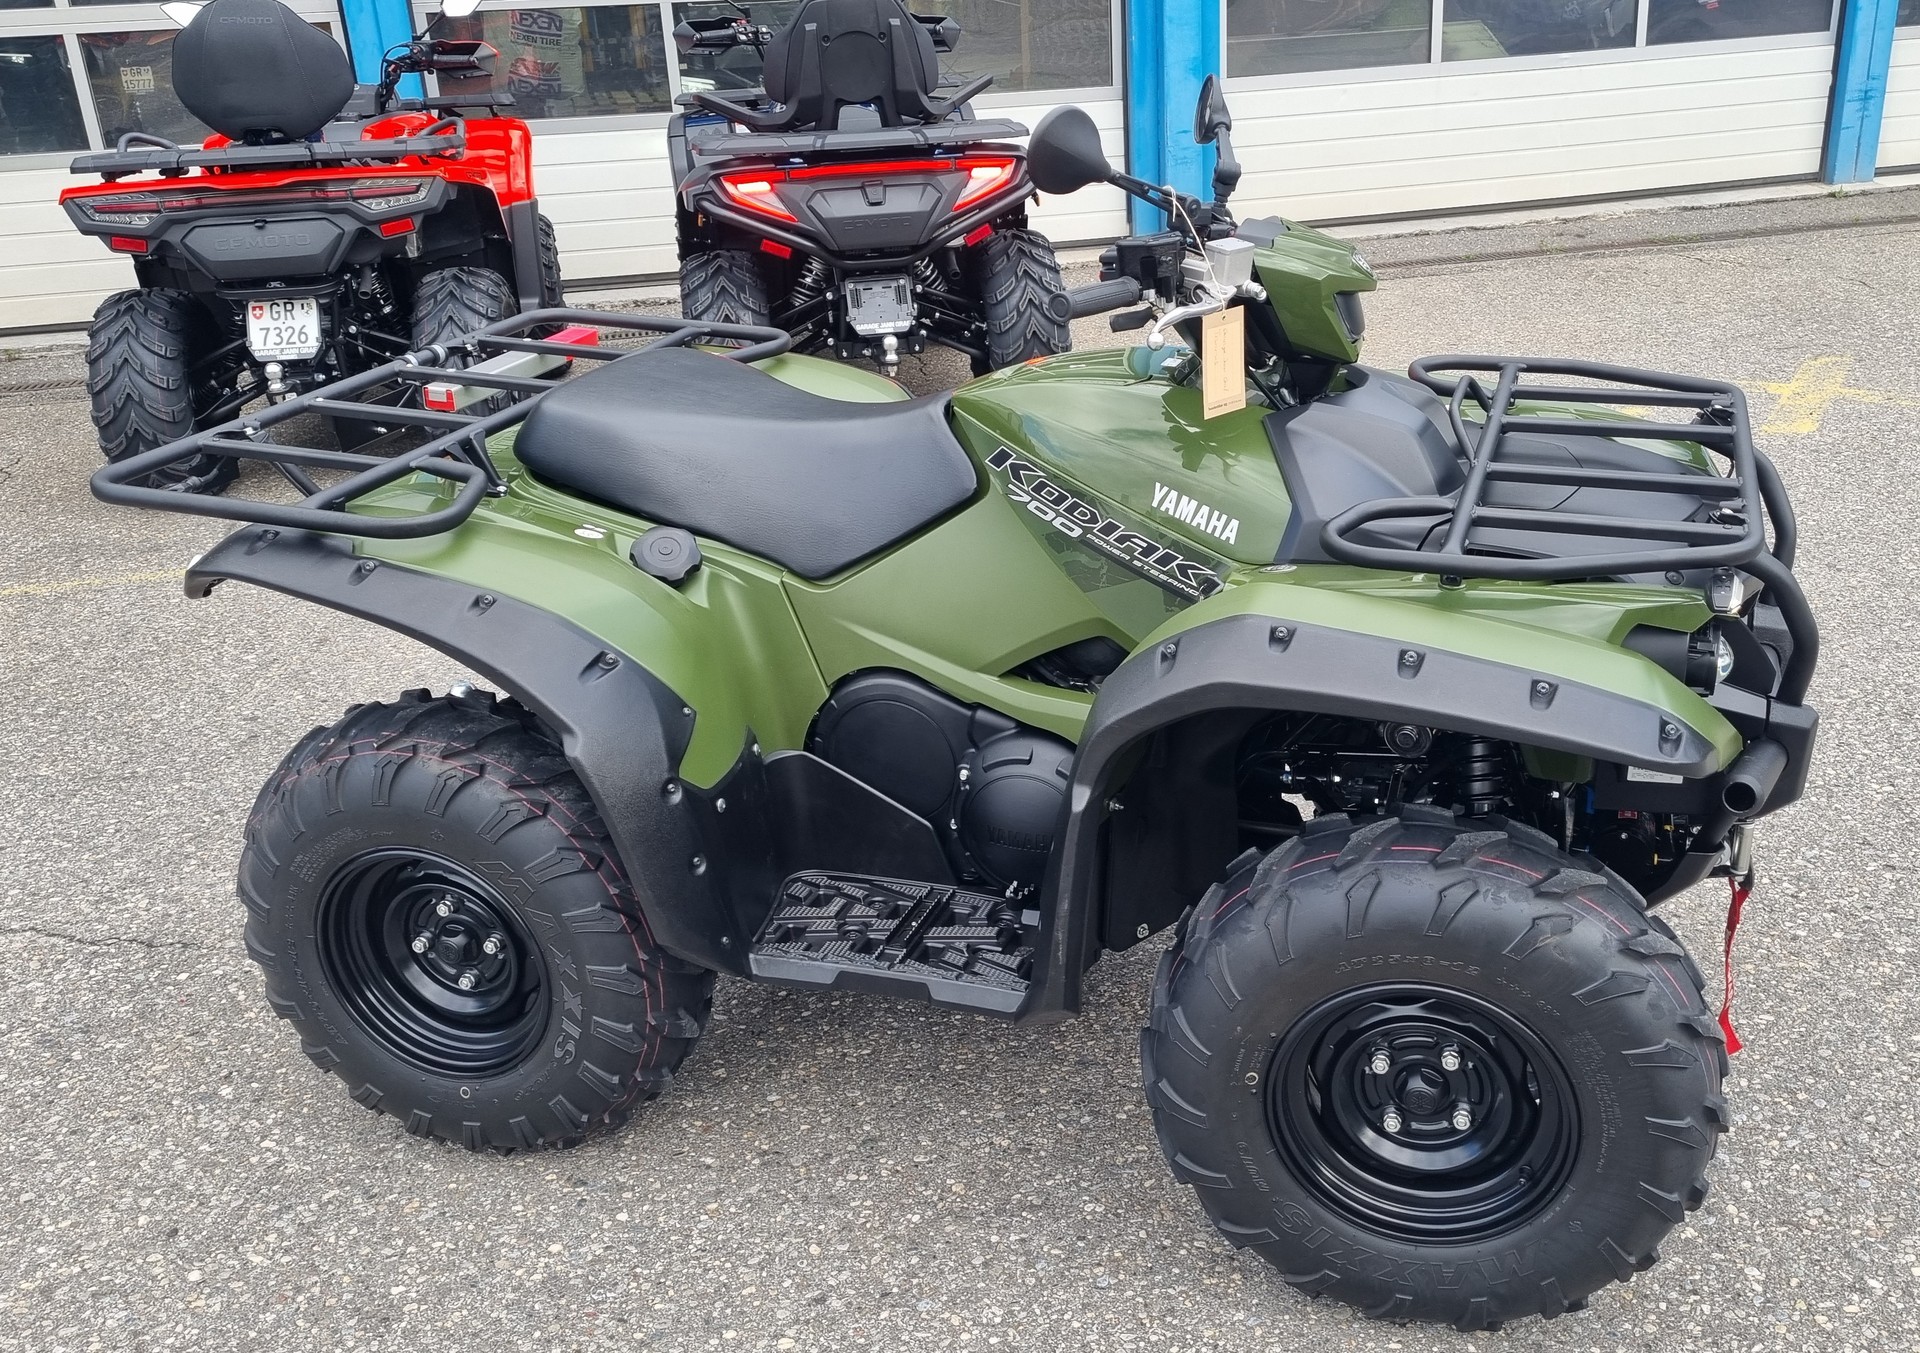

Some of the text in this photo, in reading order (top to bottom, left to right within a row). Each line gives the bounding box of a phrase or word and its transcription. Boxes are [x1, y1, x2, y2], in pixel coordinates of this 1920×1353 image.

[219, 16, 273, 24] CFMOTO
[510, 10, 563, 32] NEXEN
[540, 37, 562, 47] TIRE
[130, 67, 143, 78] GR
[215, 234, 311, 251] CFMOTO
[269, 302, 295, 321] GR
[259, 325, 309, 347] 7326
[856, 323, 880, 331] GARAGE
[254, 349, 281, 357] GARAGE
[985, 446, 1217, 588] KODIAK
[1007, 483, 1083, 538] 700
[1151, 482, 1240, 545] YAMAHA
[1086, 533, 1200, 597] POWER STEERING
[985, 826, 1050, 853] YAMAH
[473, 861, 583, 1065] MAXXIS
[1272, 1201, 1541, 1290] MAXXIS
